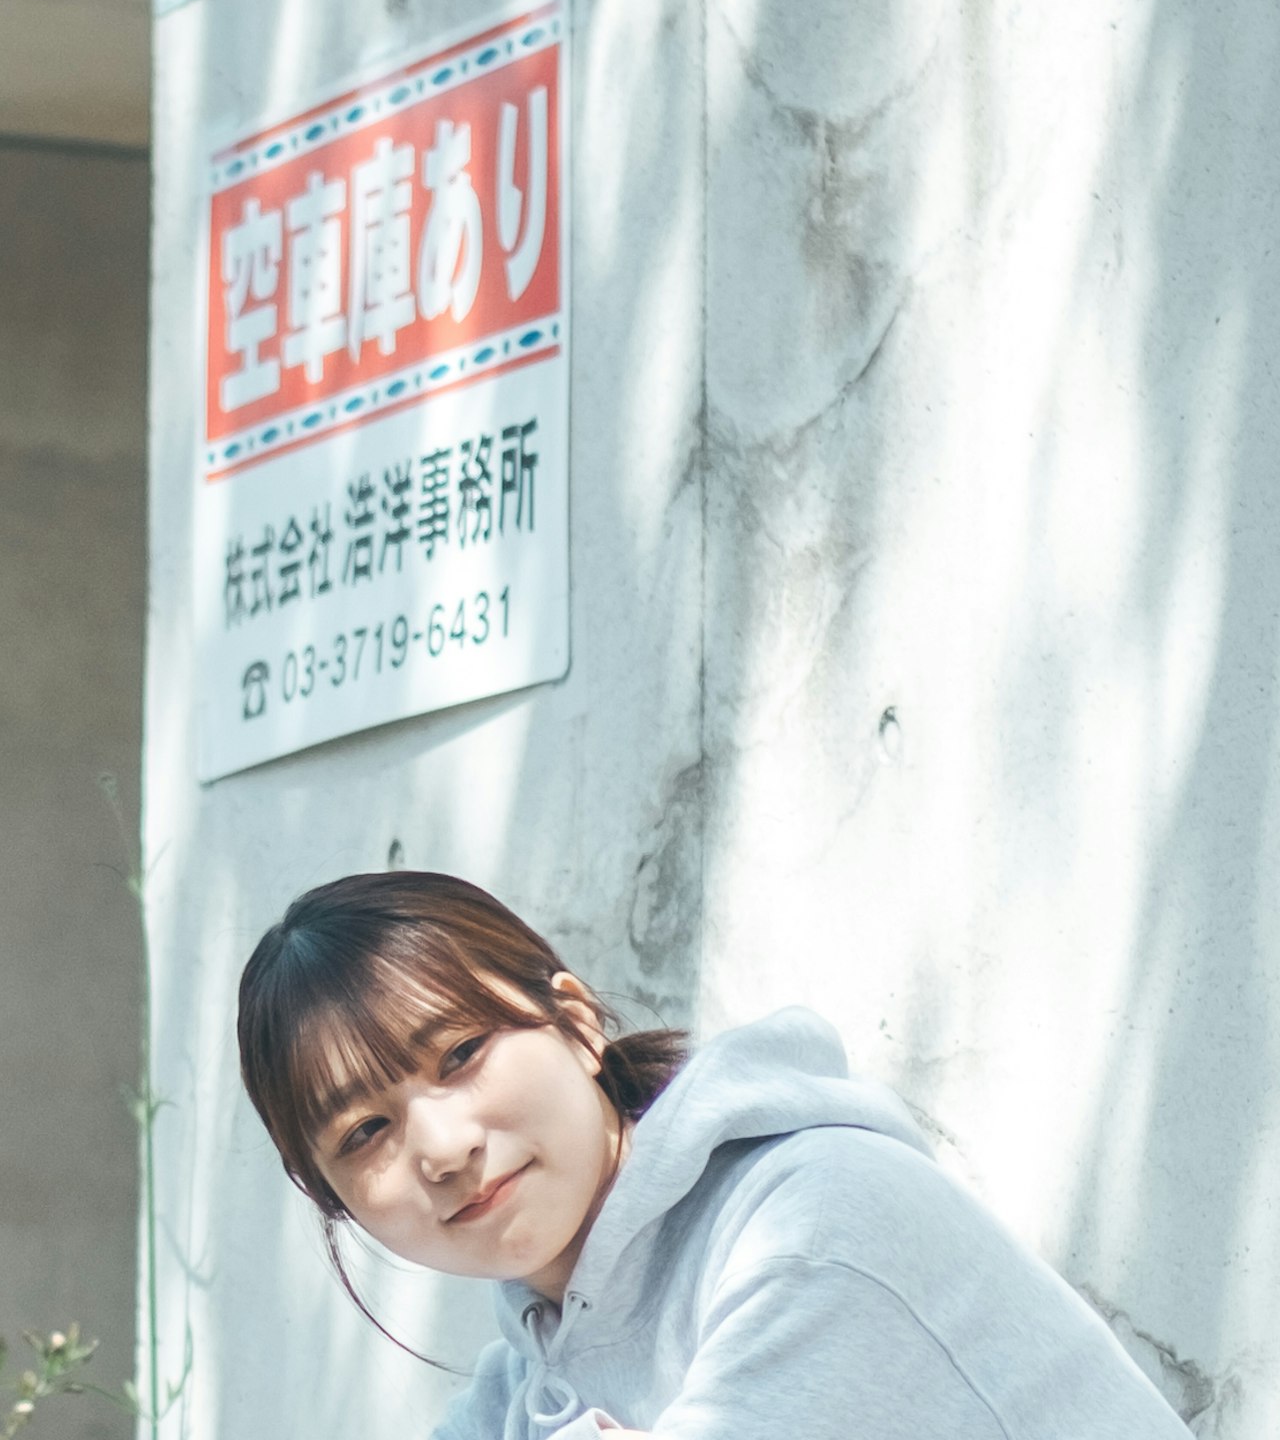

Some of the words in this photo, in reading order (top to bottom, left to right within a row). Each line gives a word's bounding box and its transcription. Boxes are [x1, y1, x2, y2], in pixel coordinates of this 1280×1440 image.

[222, 85, 548, 413] 空車庫あり
[282, 584, 510, 703] 03-3719-6431
